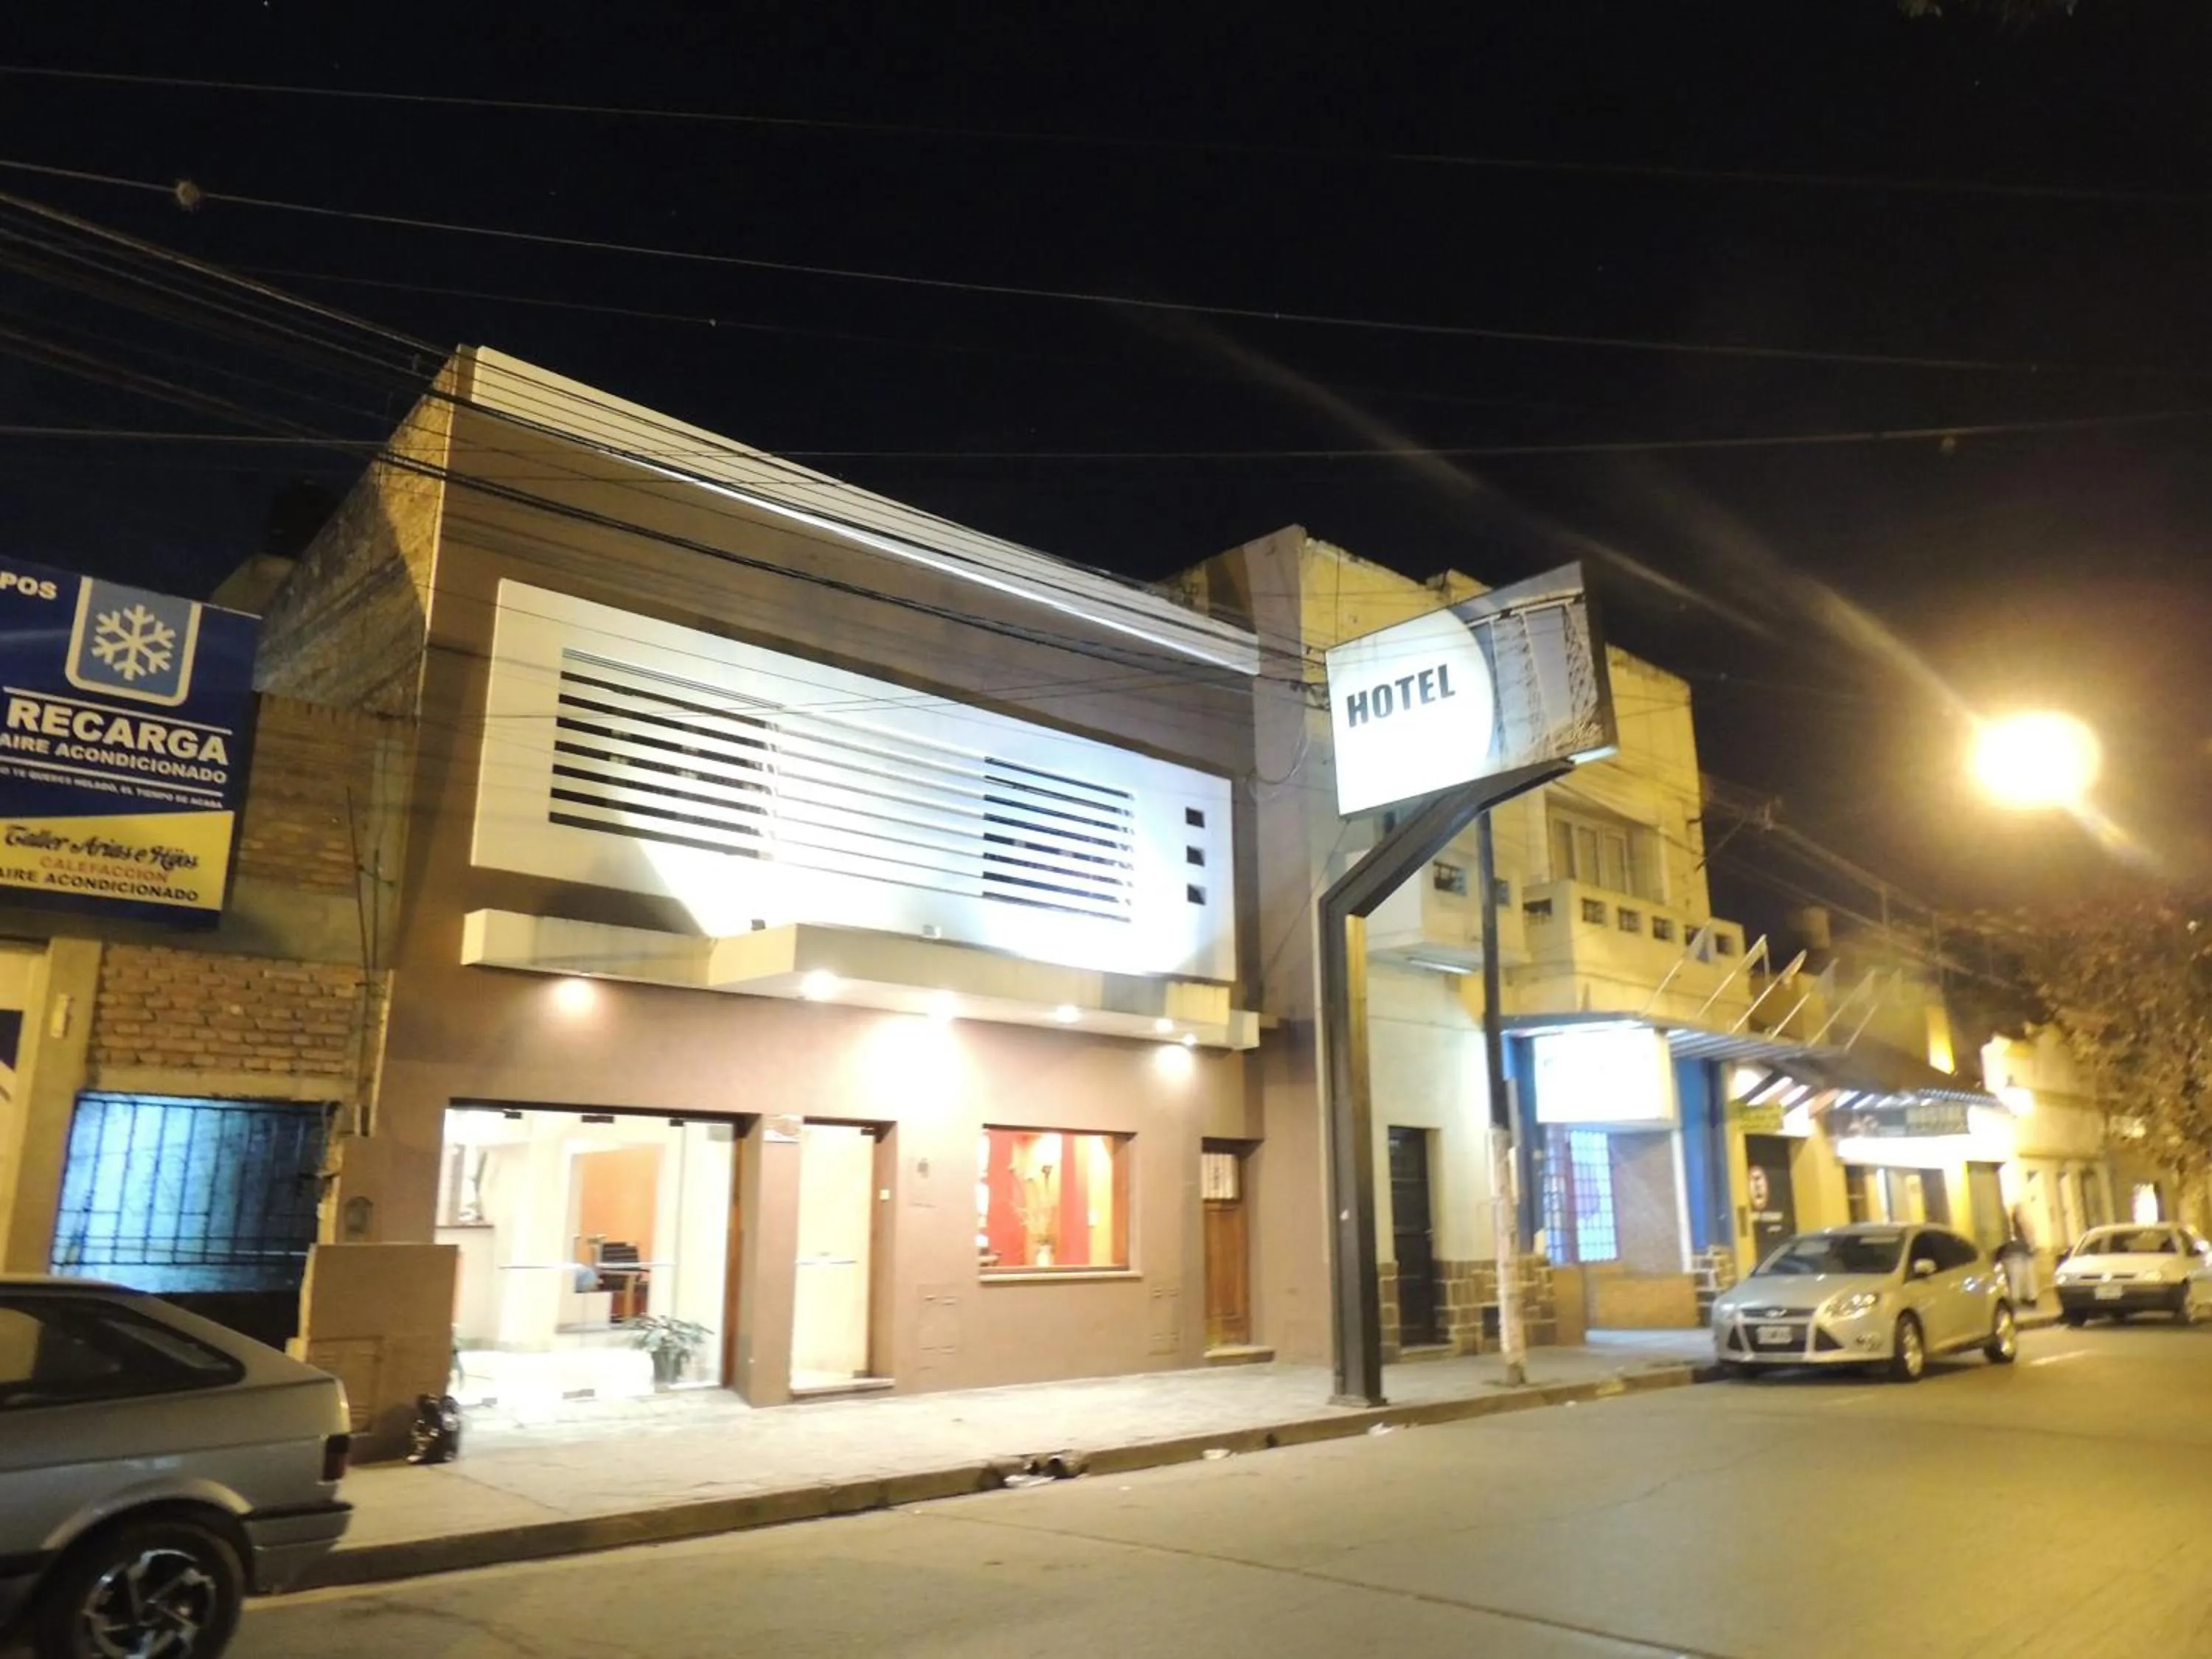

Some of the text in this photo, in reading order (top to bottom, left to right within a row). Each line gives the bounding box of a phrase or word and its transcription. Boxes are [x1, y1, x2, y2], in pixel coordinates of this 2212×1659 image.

[1346, 664, 1456, 728] HOTEL
[0, 733, 228, 785] AIRE ACONDICIONADO
[7, 698, 229, 765] RECARGA
[44, 873, 198, 902] ACONDICIONADO
